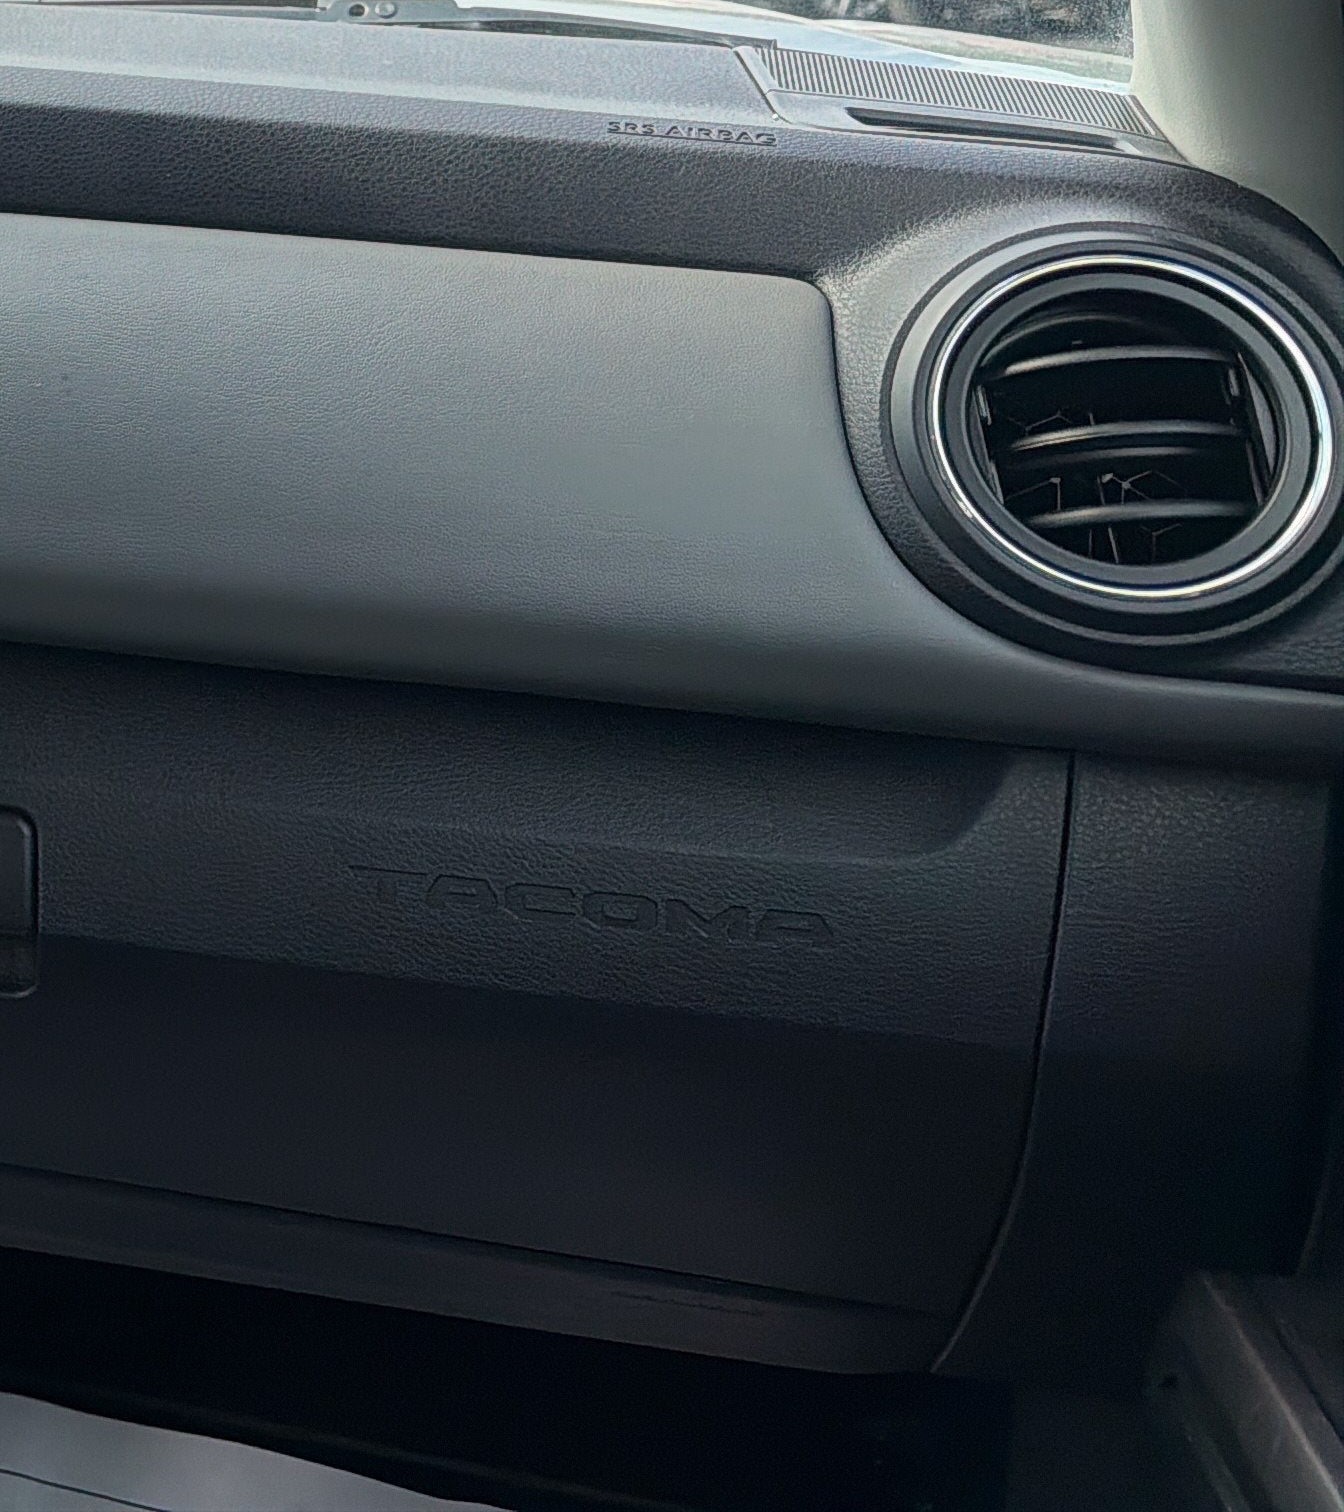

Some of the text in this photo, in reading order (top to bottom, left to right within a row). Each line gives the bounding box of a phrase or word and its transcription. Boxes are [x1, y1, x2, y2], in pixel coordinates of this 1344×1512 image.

[607, 121, 777, 145] SRS AIRBAG
[347, 864, 835, 944] TACOMA
